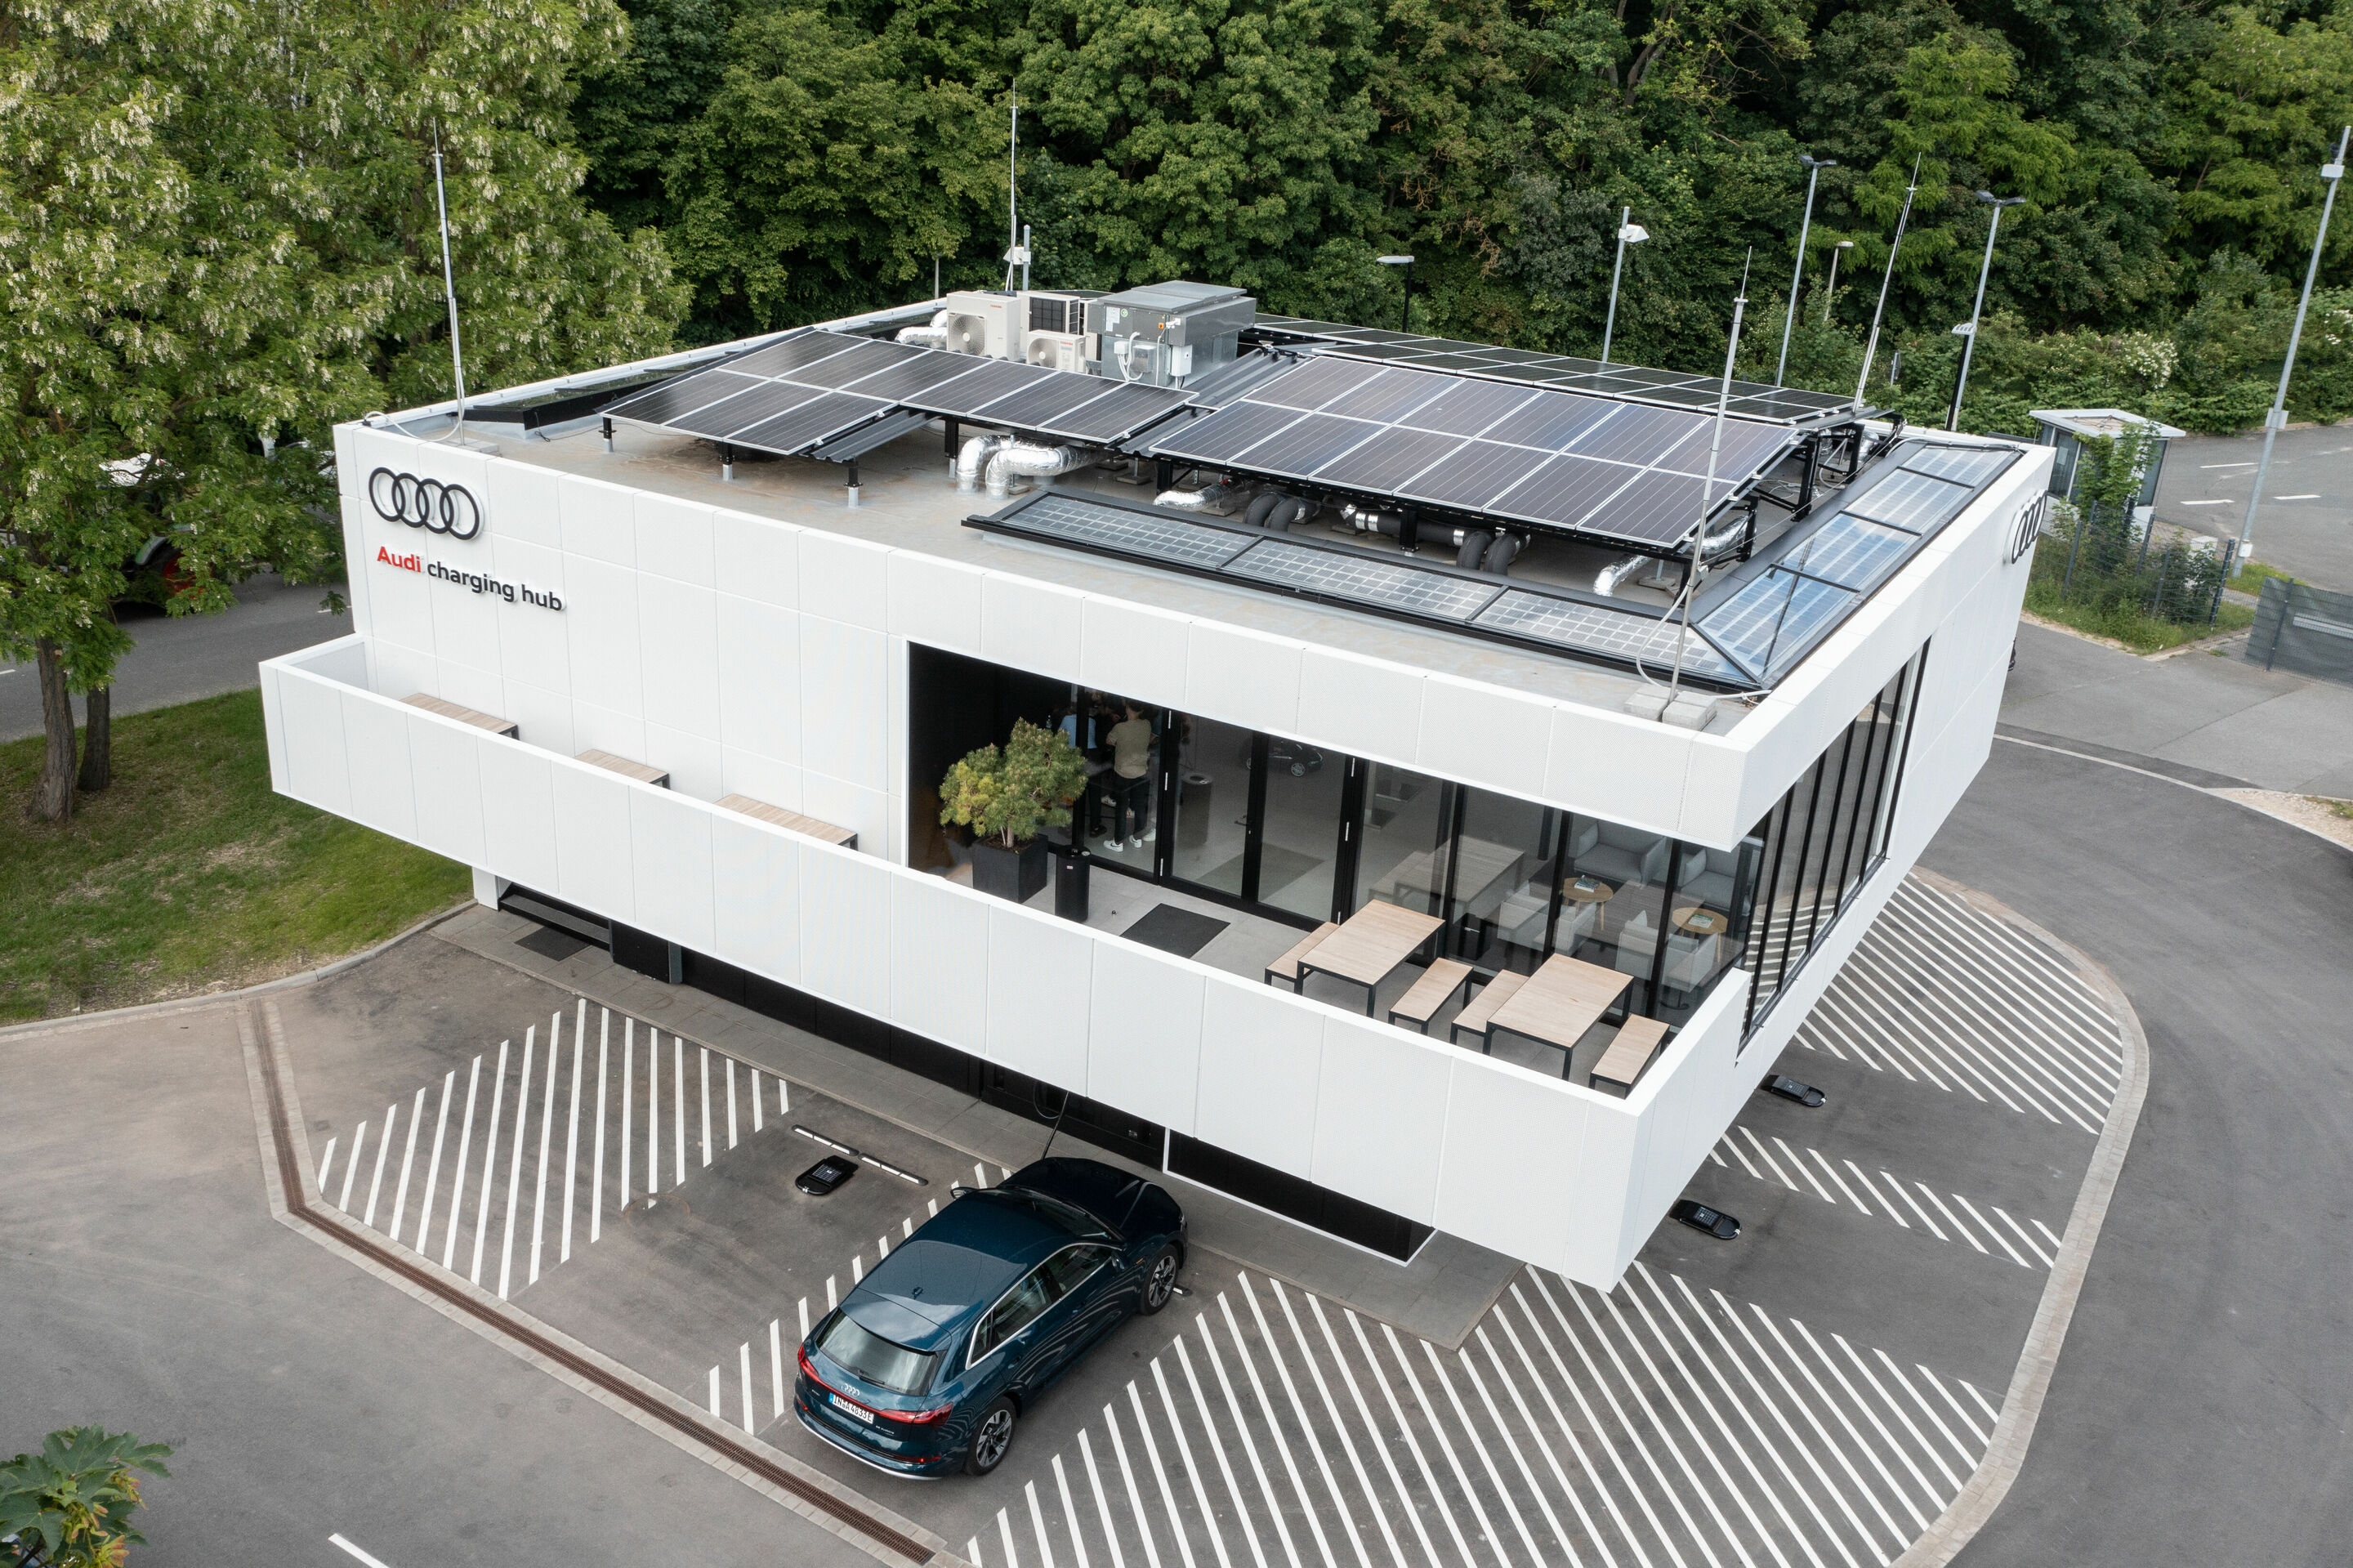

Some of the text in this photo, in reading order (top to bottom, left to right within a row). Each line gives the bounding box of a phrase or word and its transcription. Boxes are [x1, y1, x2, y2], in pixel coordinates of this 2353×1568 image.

[377, 546, 563, 611] Audi charging hub
